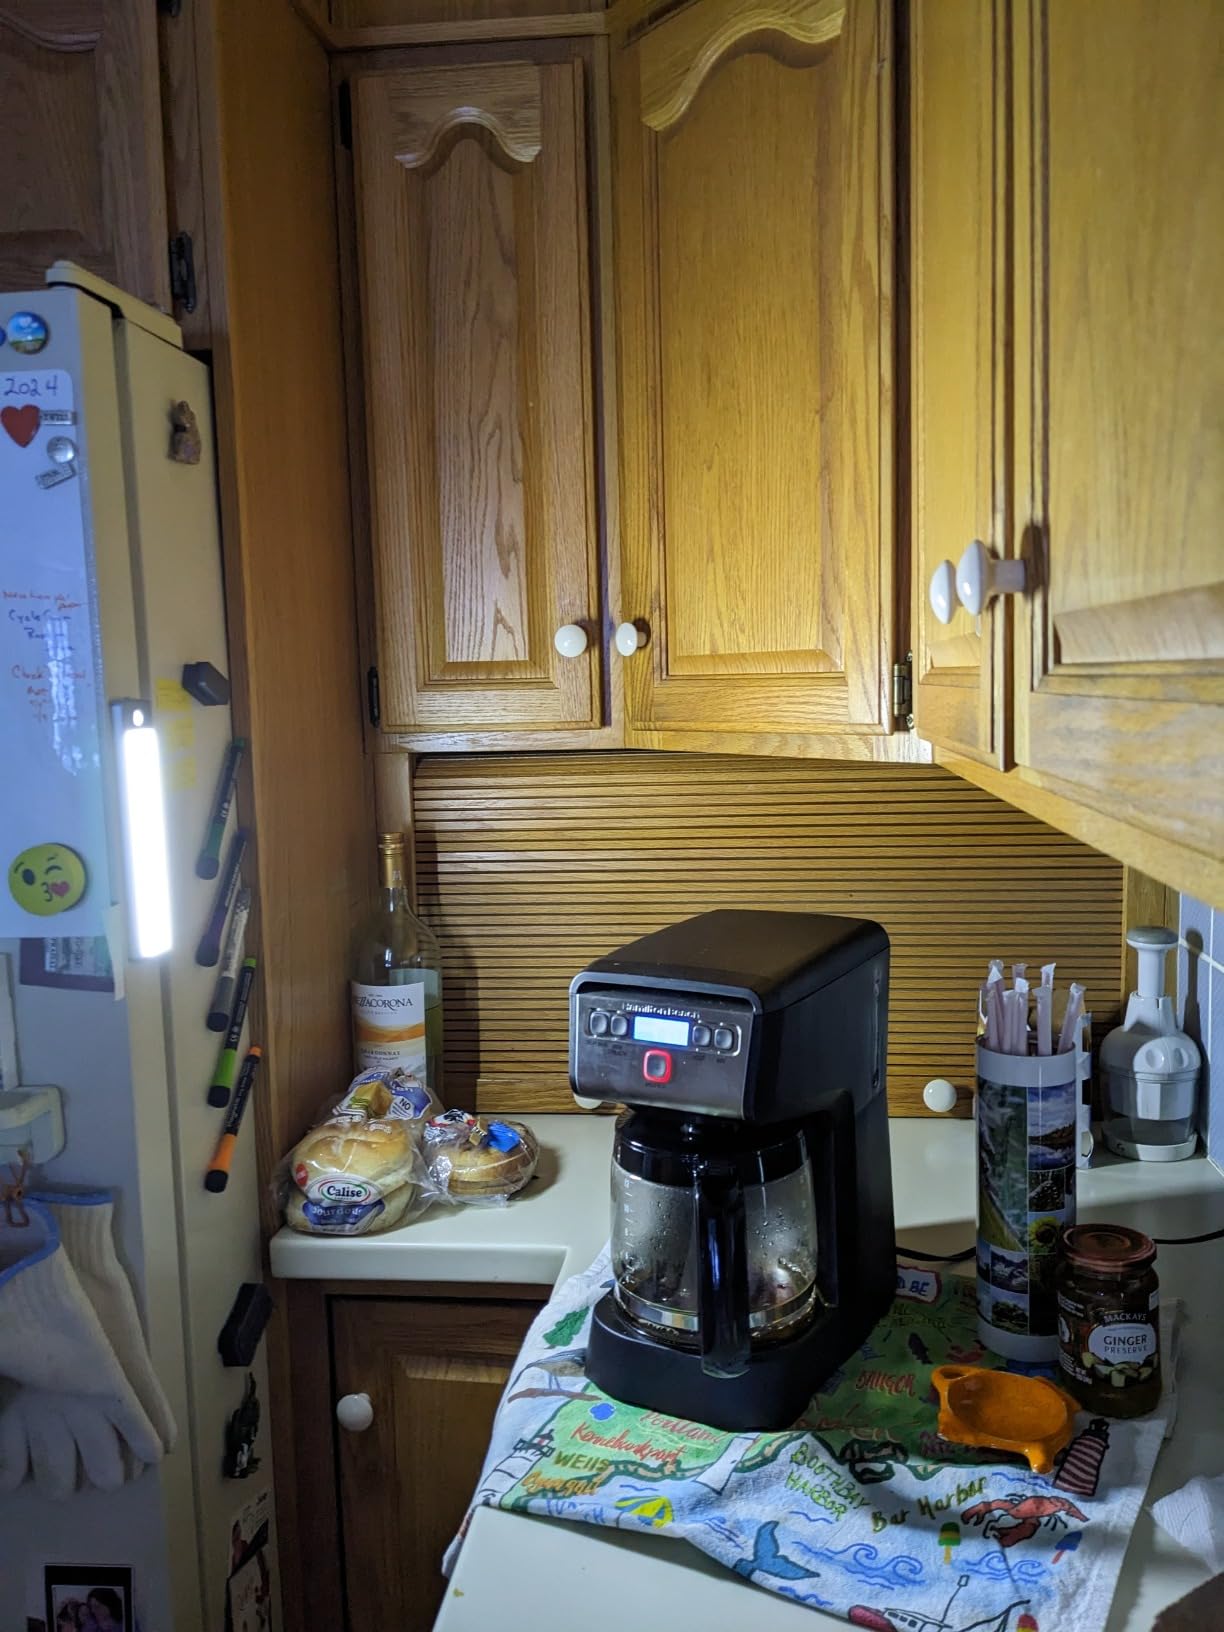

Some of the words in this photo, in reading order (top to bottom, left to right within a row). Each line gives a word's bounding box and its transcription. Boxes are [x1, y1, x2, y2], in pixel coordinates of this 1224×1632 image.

[4, 375, 58, 397] 2024
[399, 1098, 411, 1110] NO
[327, 1185, 362, 1197] Calise
[909, 1280, 929, 1296] BE
[1103, 1312, 1147, 1322] MACKAYS
[1103, 1334, 1148, 1346] GINGER
[1104, 1345, 1147, 1354] PRESERVE
[871, 1509, 910, 1533] Bar
[917, 1476, 987, 1520] Harbor
